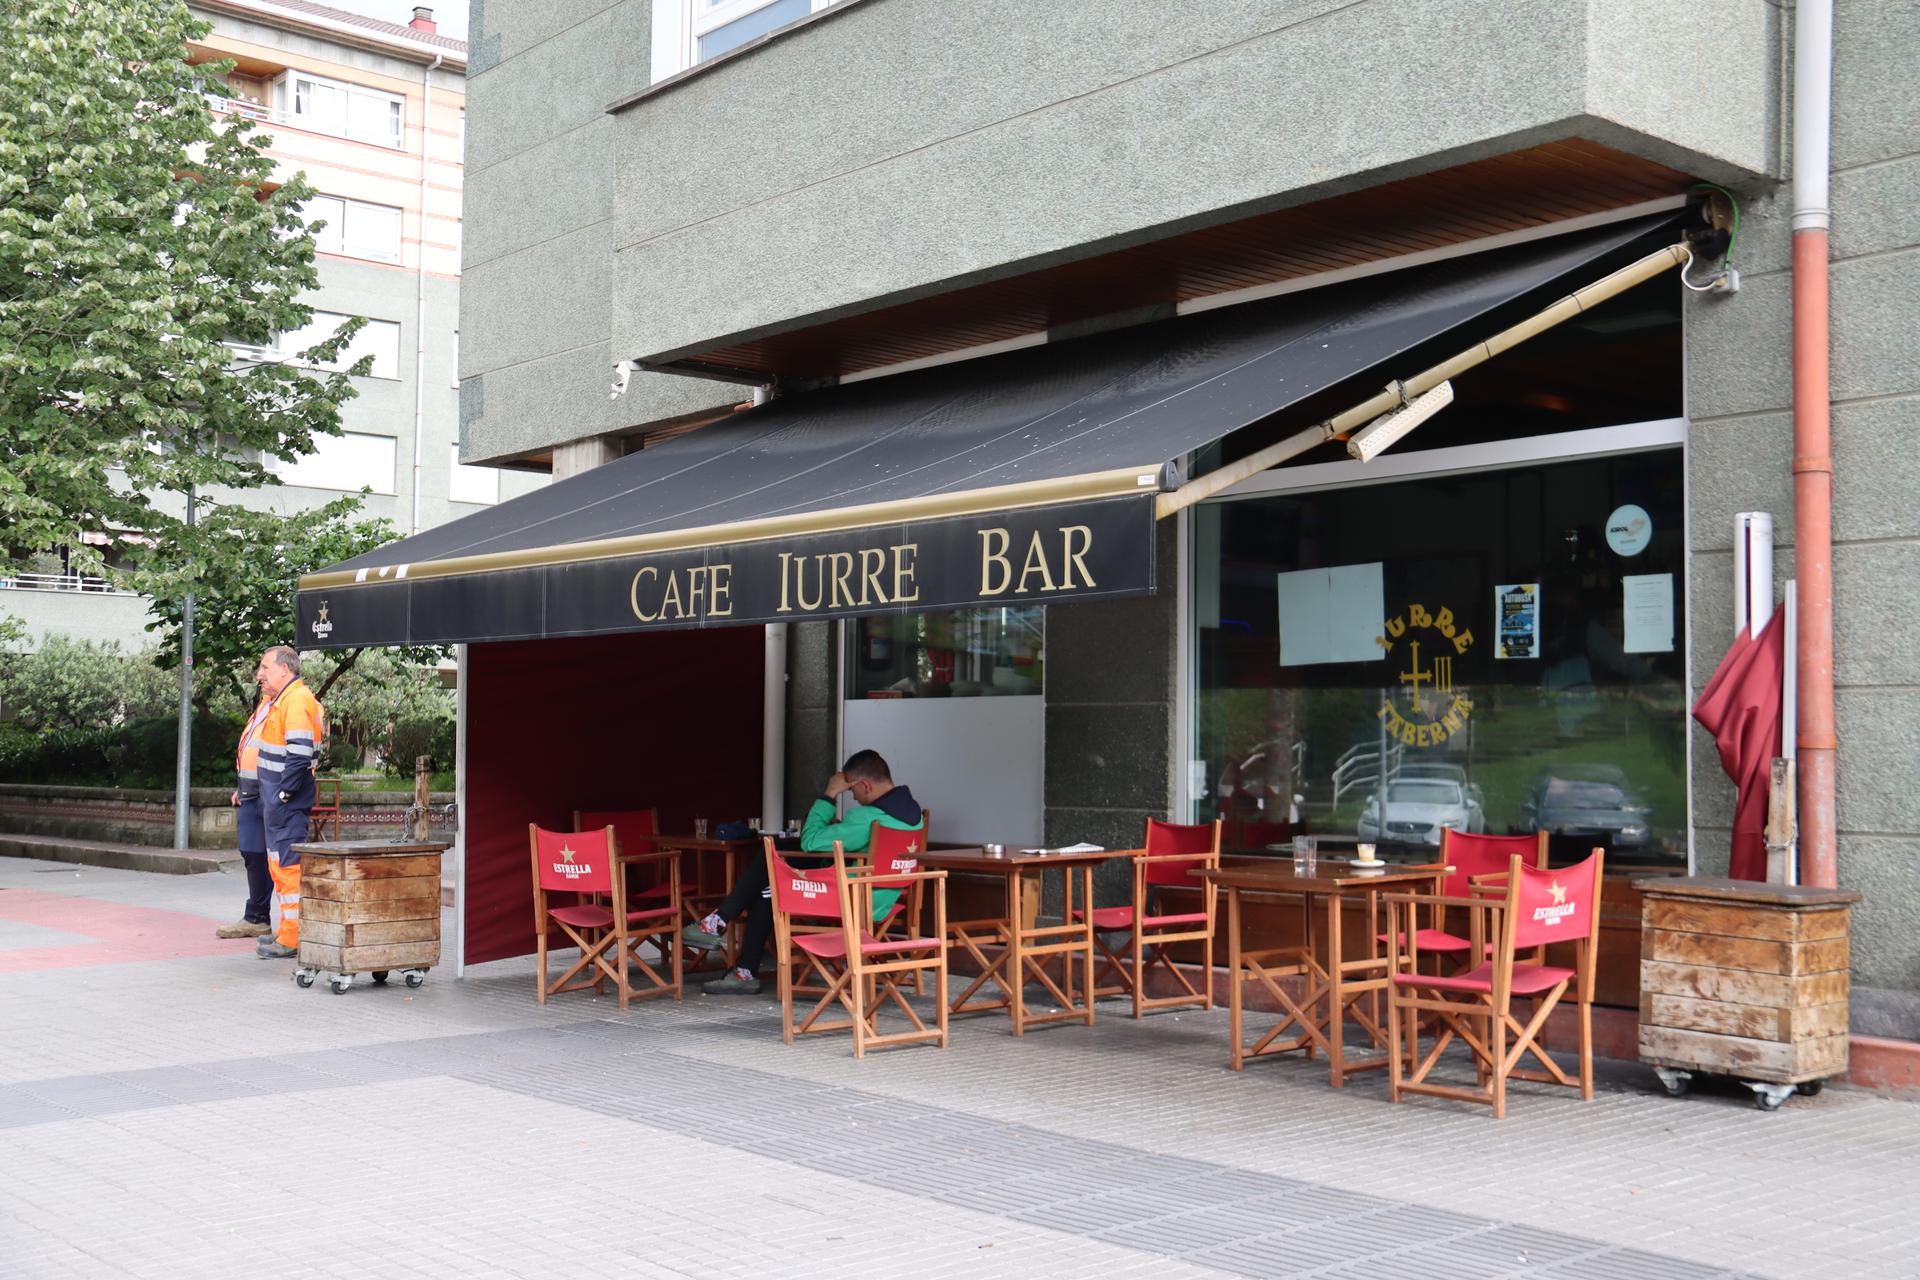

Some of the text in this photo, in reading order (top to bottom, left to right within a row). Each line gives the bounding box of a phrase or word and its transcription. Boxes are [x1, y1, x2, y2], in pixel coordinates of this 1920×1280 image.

[630, 524, 1098, 622] CAFE IURRE BAR
[552, 863, 592, 874] ESTRELLA
[791, 879, 828, 894] ESTRELLA
[1533, 902, 1575, 920] ESTRELLA
